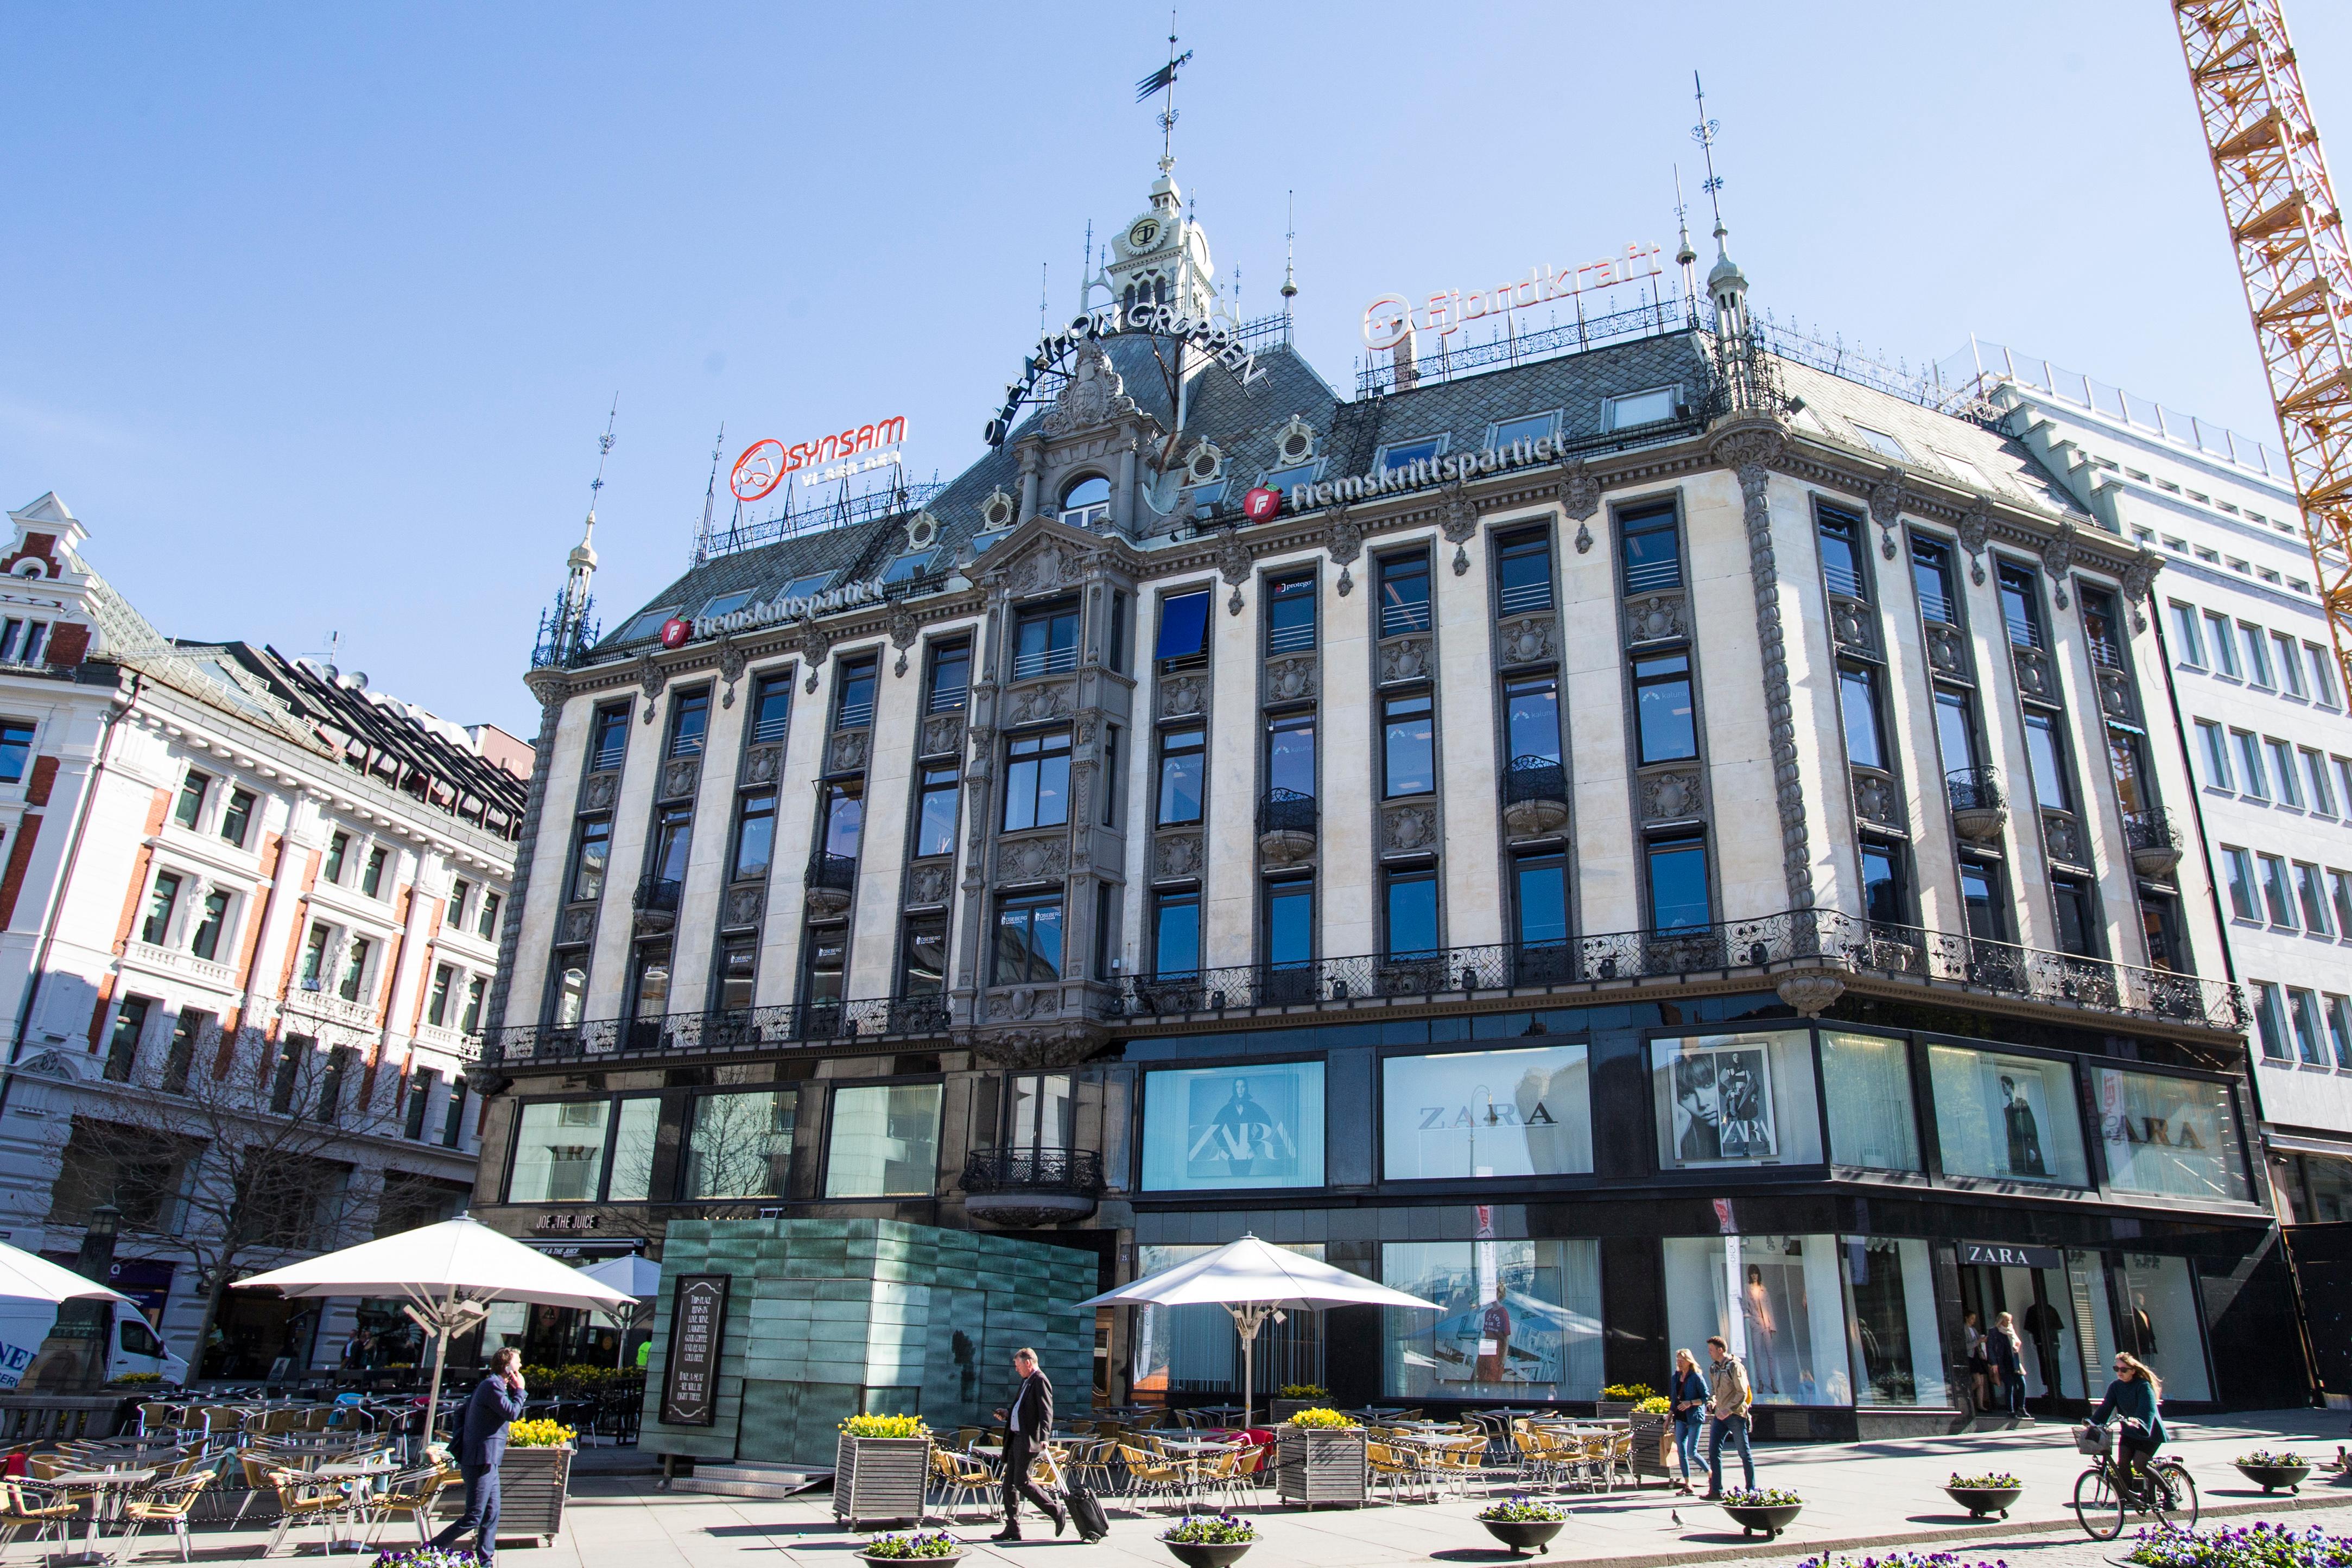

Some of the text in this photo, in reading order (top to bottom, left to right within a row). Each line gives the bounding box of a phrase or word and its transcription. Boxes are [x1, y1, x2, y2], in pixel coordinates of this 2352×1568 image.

[1422, 240, 1662, 335] Fjordkraft
[1035, 313, 1120, 363] THON
[1127, 302, 1267, 386] GRUPPEN
[787, 416, 908, 472] SYNSAM
[802, 450, 902, 487] VI SER DEG
[1292, 431, 1567, 511] Fremskrittspartiet
[1286, 581, 1311, 591] protego
[693, 575, 886, 639] Fremskrittspartiet
[1662, 690, 1687, 699] kaluna
[1531, 710, 1555, 719] kaluna
[1291, 745, 1313, 753] kaluna
[1418, 1102, 1558, 1130] ZARA
[1188, 1120, 1296, 1161] ZARA
[1721, 1120, 1771, 1143] ZARA
[536, 1215, 551, 1229] JOE
[556, 1215, 570, 1229] THE
[572, 1215, 595, 1229] JUICE
[1969, 1247, 2030, 1265] ZARA
[691, 1295, 712, 1304] THIS PLACE
